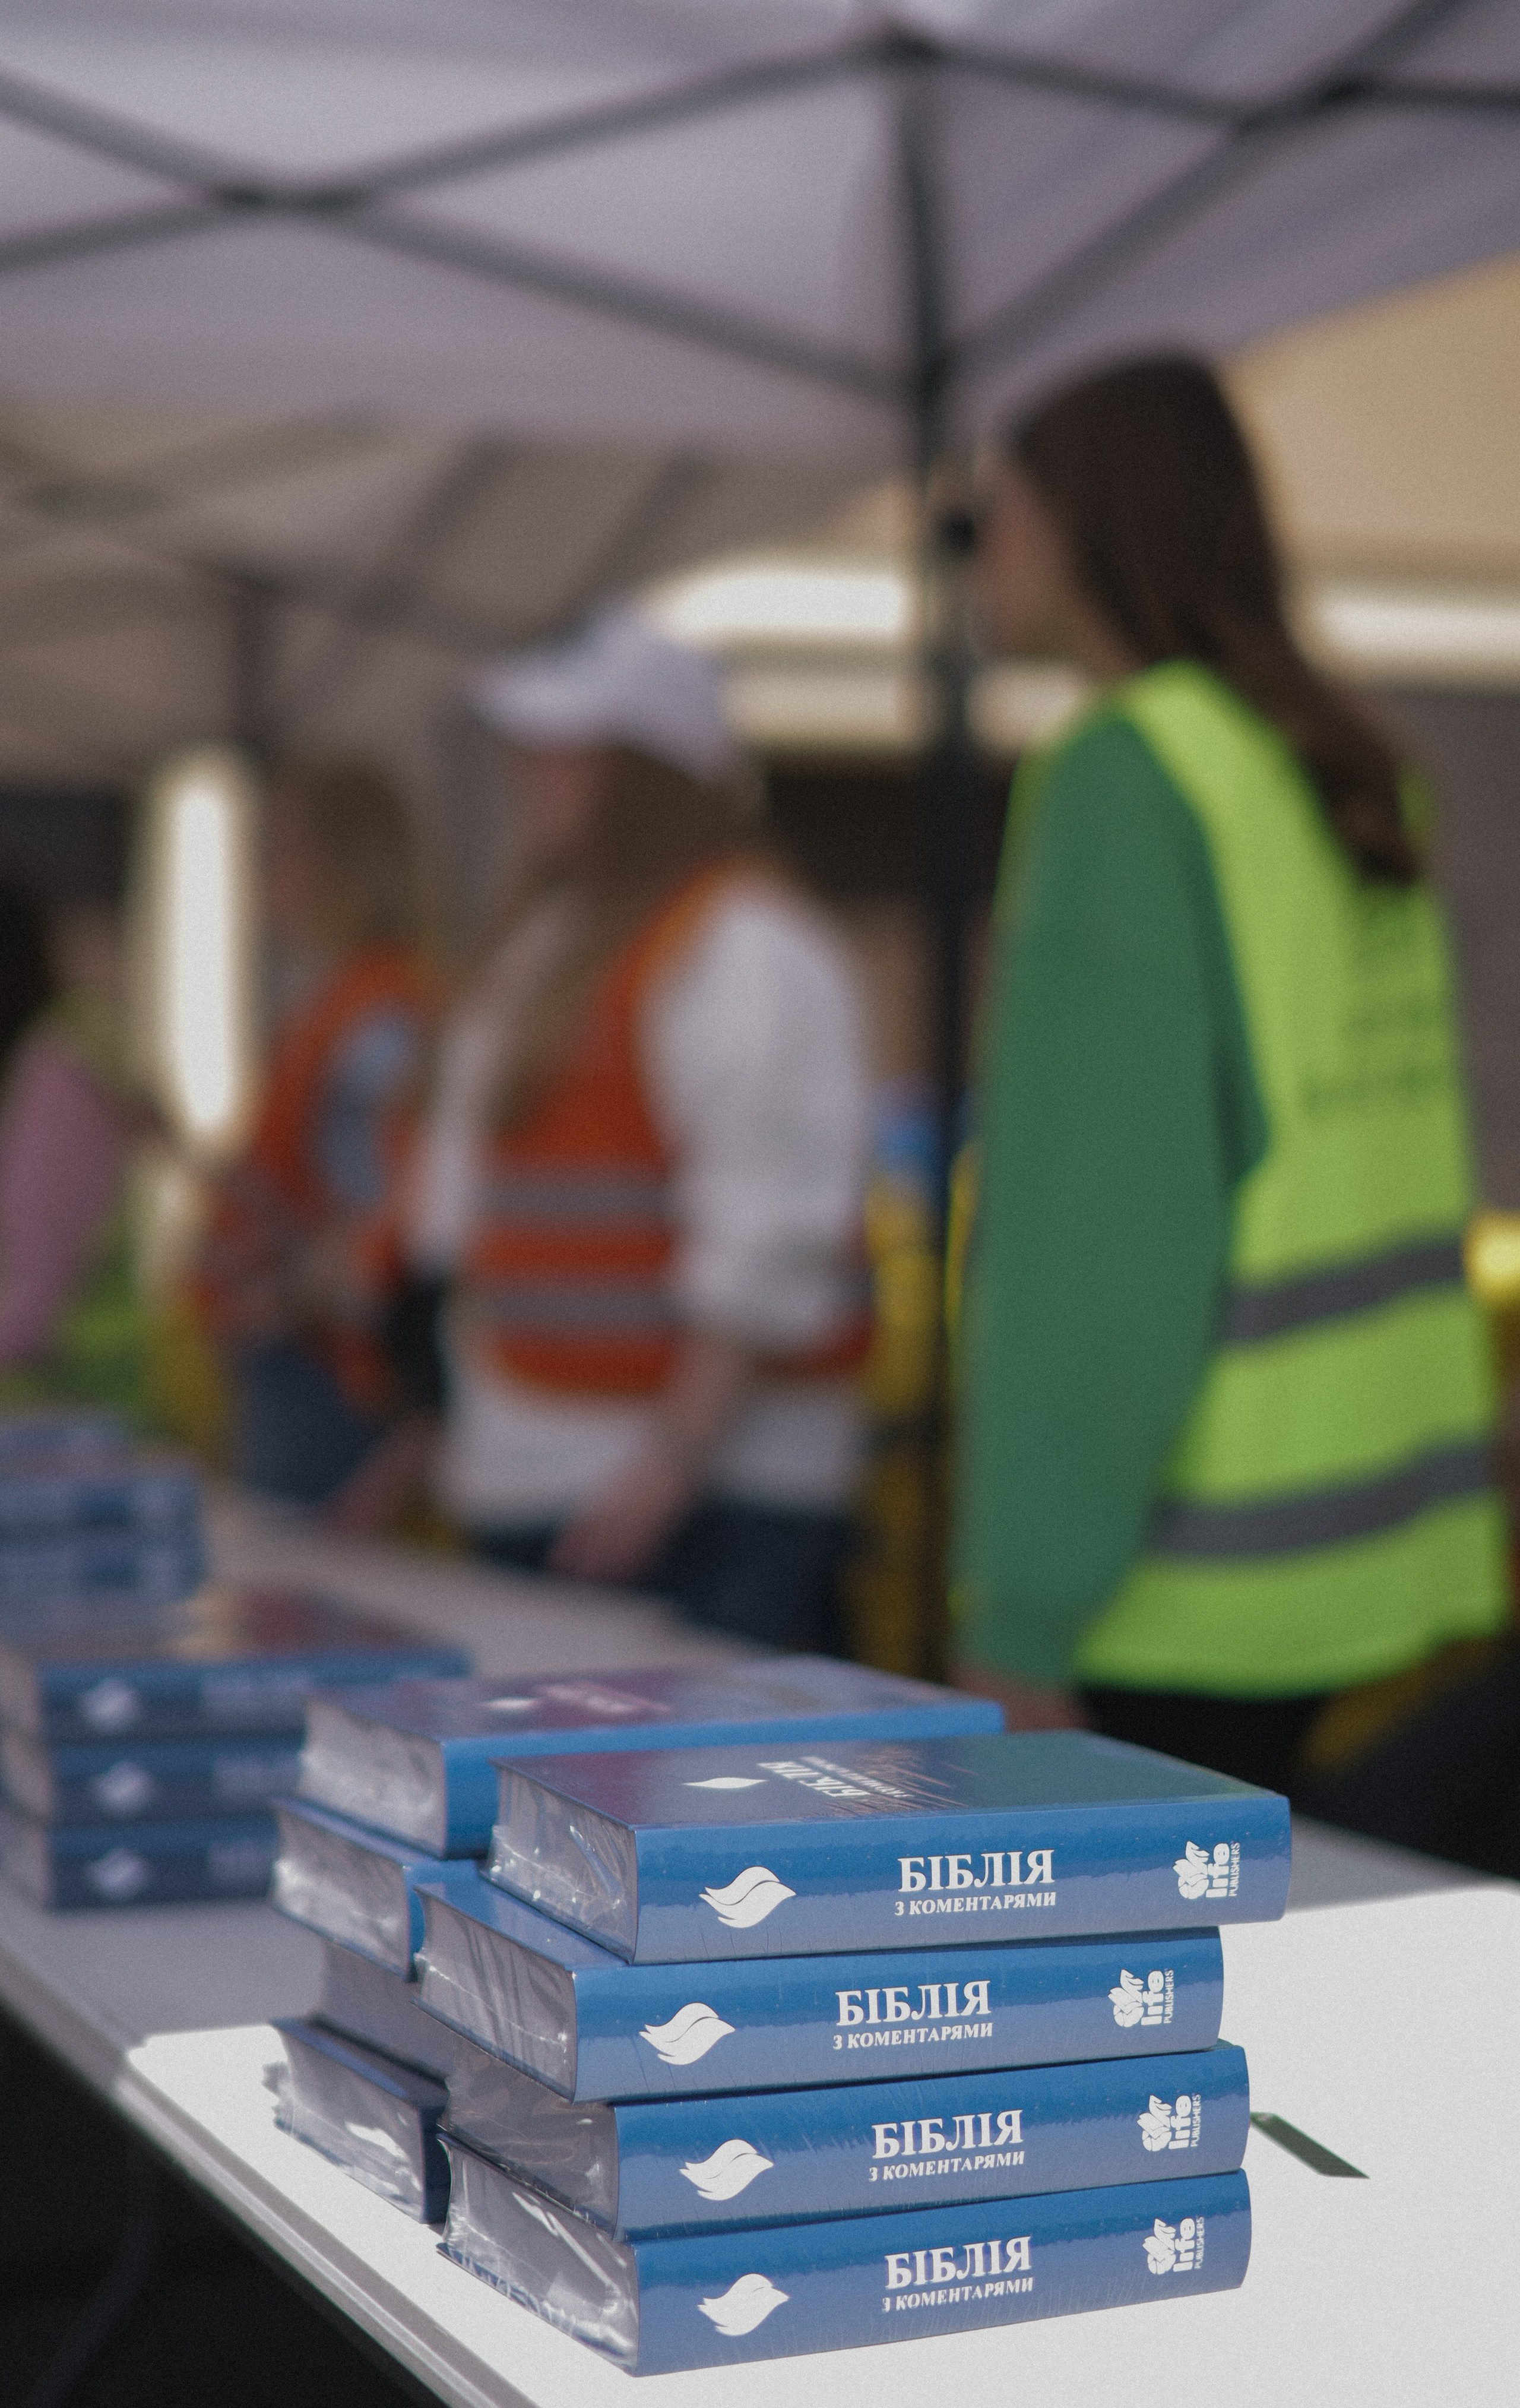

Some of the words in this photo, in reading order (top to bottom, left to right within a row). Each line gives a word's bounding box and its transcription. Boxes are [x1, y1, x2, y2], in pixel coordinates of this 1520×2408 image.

[898, 1850, 1054, 1892] БІБЛІЯ
[1206, 1844, 1229, 1898] life
[895, 1901, 904, 1916] З
[910, 1892, 1056, 1915] КОМЕНТАРЯМИ
[836, 1981, 991, 2026] БІБЛІЯ
[1141, 1971, 1164, 2026] life
[1164, 1970, 1174, 2023] PUBLISHERS
[834, 2035, 843, 2050] З
[848, 2023, 993, 2049] КОМЕНТАРЯМИ
[873, 2110, 1023, 2159] БІБЛІЯ
[1168, 2096, 1191, 2149] life
[869, 2167, 878, 2181] З
[883, 2151, 1024, 2180] КОМЕНТАРЯМИ
[886, 2237, 1031, 2289] БІБЛІЯ
[1173, 2219, 1195, 2272] life
[883, 2298, 891, 2312] З
[896, 2277, 1033, 2310] КОМЕНТАРЯМИ
